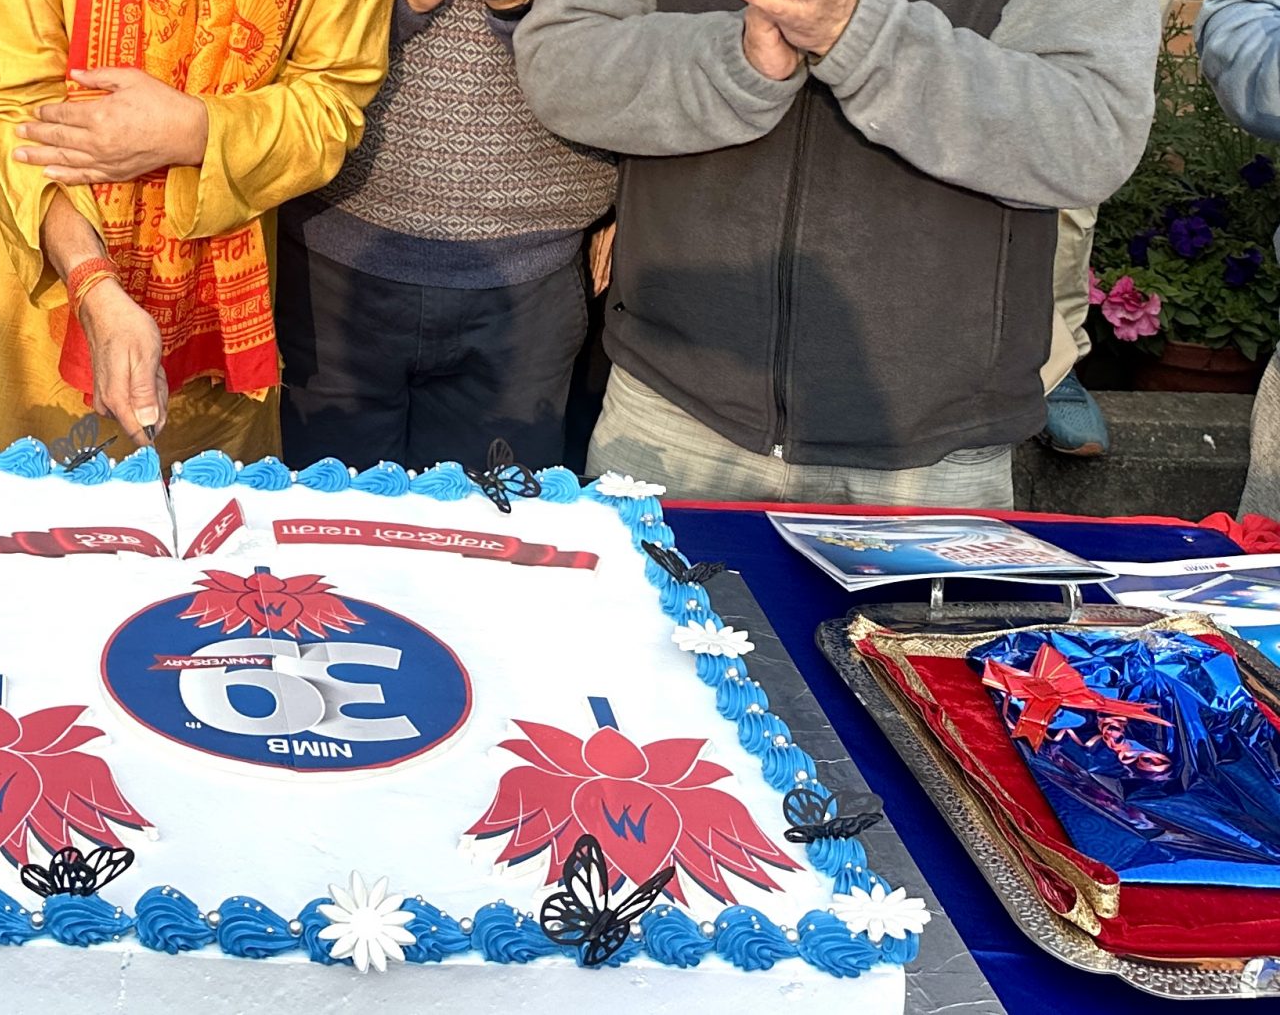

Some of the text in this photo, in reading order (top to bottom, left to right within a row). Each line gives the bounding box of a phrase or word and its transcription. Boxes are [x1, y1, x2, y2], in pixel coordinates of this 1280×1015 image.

[281, 524, 361, 537] पथमा
[162, 657, 266, 668] ANNIVERSARY
[179, 637, 421, 743] 39
[267, 738, 353, 759] NIMB
